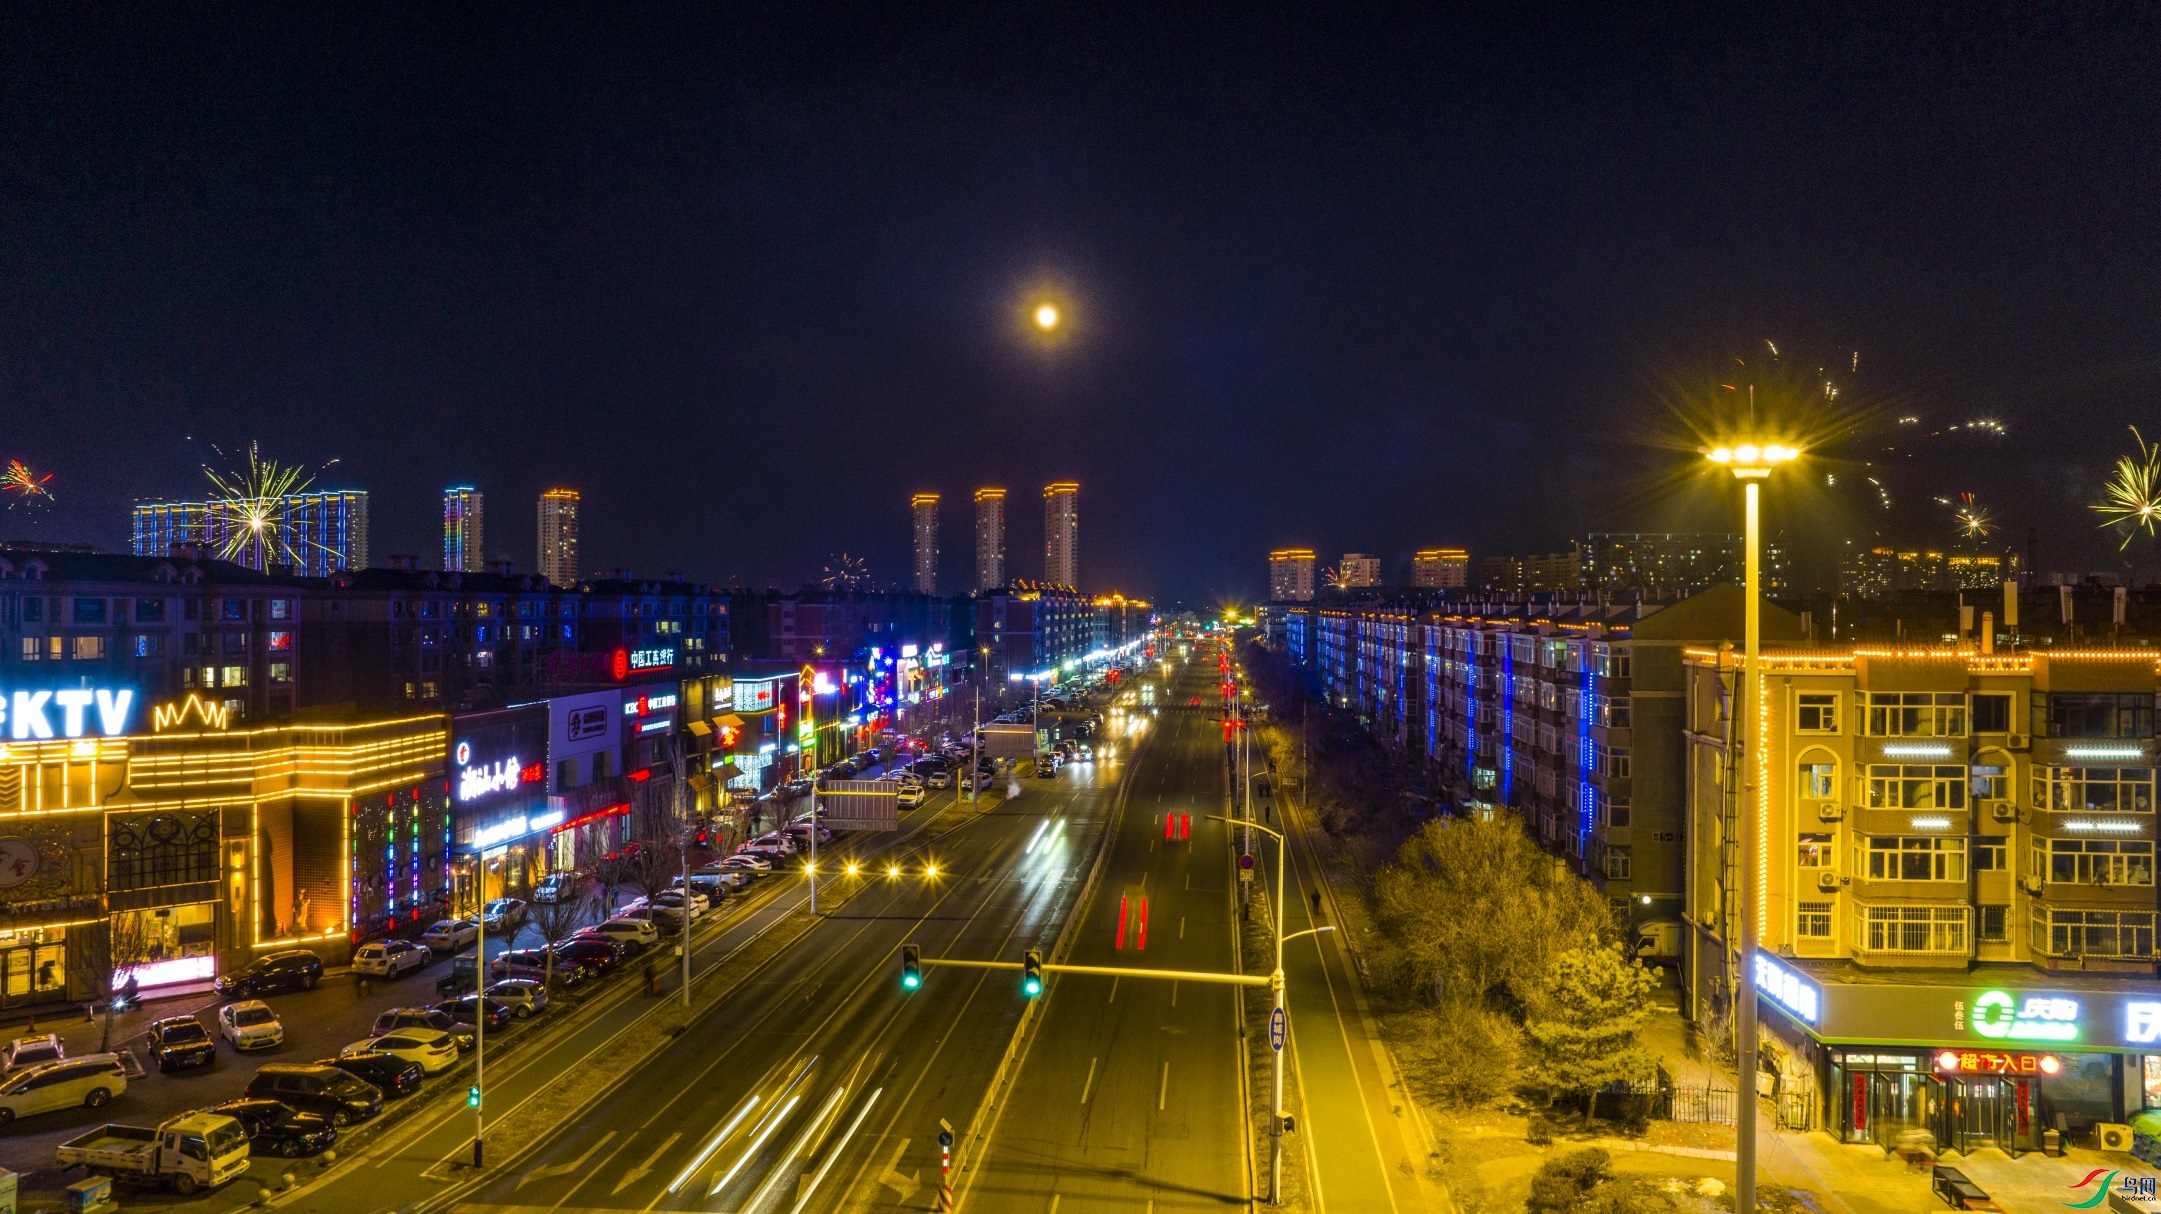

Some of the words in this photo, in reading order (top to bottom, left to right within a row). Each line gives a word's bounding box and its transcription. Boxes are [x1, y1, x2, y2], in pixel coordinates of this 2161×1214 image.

[630, 649, 674, 669] 中国工商银行
[1954, 1001, 1965, 1030] 伍叁伍
[1960, 1053, 2037, 1072] 超市入口
